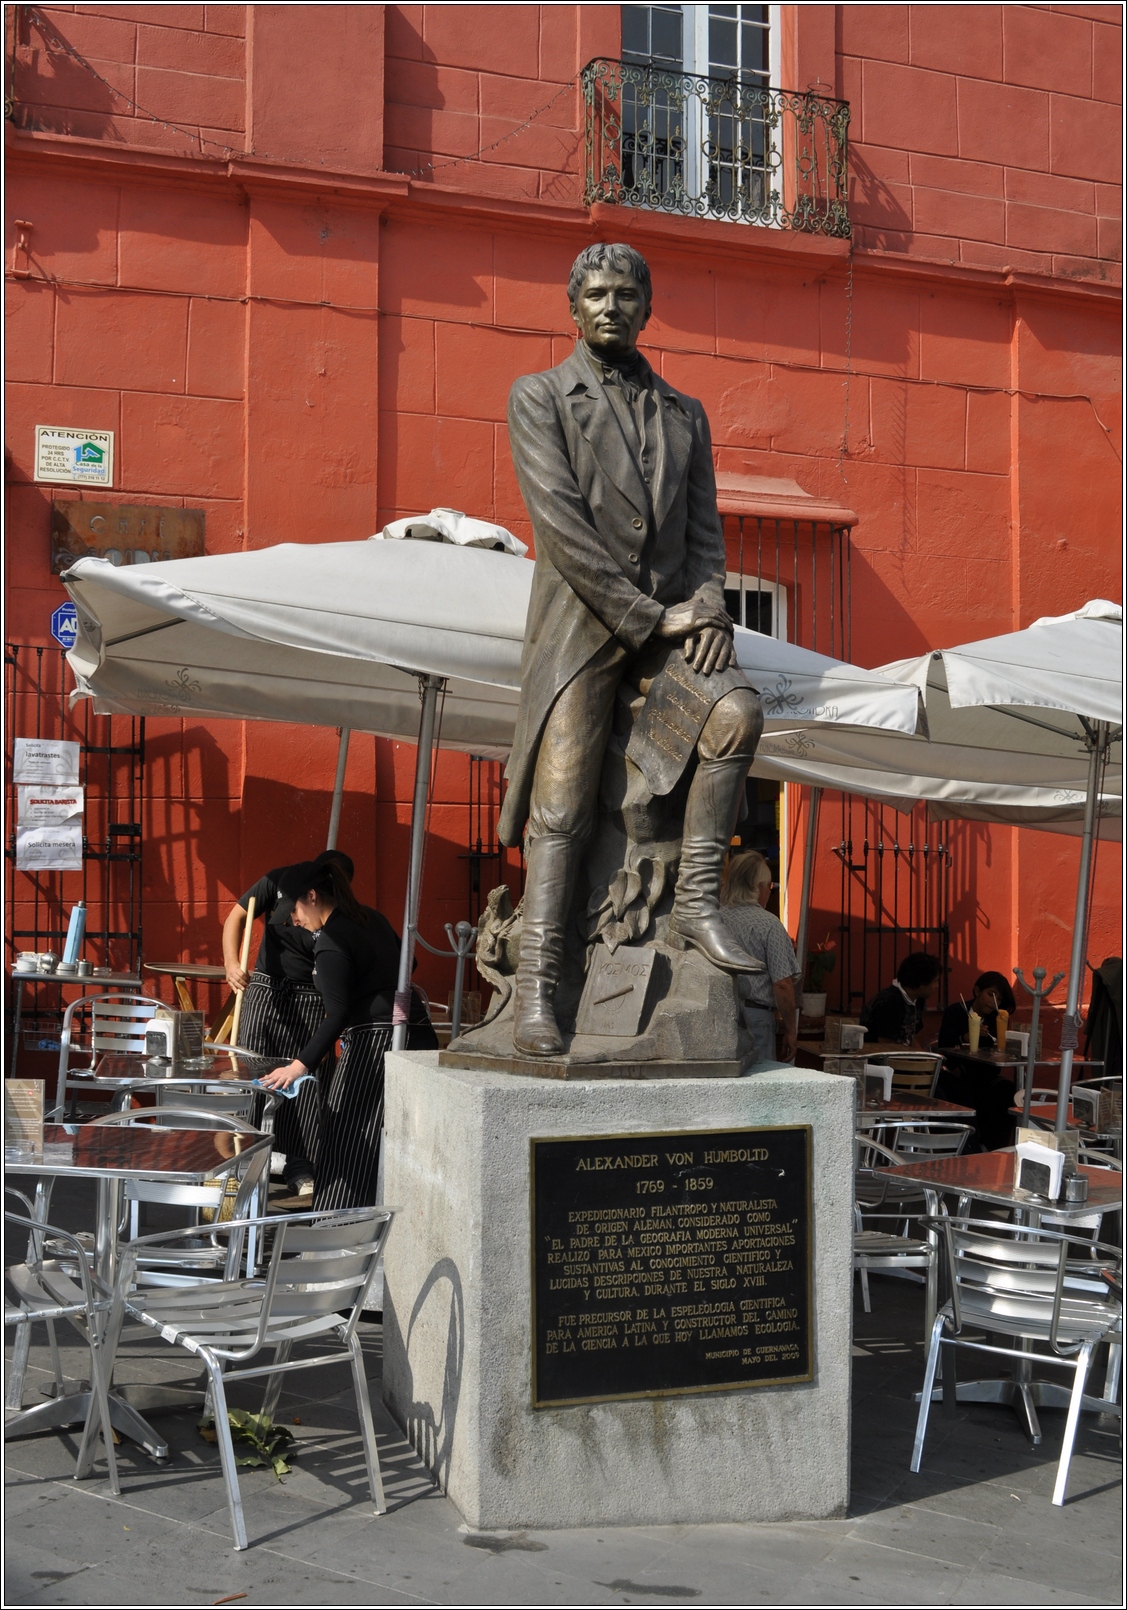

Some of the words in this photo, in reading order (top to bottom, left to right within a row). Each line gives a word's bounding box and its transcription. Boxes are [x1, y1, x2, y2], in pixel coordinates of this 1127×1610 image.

[41, 430, 107, 442] ATENCIÓN
[73, 466, 105, 474] Seguridad
[26, 751, 61, 759] lavatrastes
[576, 1155, 659, 1171] ALEXANDER
[665, 1152, 694, 1166] VON
[704, 1149, 769, 1164] HUMBOLTD
[636, 1180, 665, 1194] 1769
[685, 1178, 714, 1191] 1859
[568, 1208, 646, 1222] EXPEDICIONARIO
[652, 1204, 708, 1217] FILANTROPO
[711, 1203, 717, 1213] Y
[720, 1199, 778, 1212] NATURALISTA
[576, 1224, 589, 1235] DE
[595, 1221, 629, 1233] ORIGEN
[678, 1214, 740, 1228] CONSIDERADO
[747, 1212, 771, 1223] COMO
[548, 1251, 590, 1264] REALIZO
[598, 1248, 623, 1260] PARA
[628, 1245, 662, 1258] MEXICO
[666, 1241, 728, 1256] IMPORTANTES
[732, 1235, 796, 1250] APORTACIONES
[570, 1236, 600, 1249] PADRE
[605, 1235, 617, 1246] DE
[622, 1235, 635, 1246] LA
[641, 1231, 692, 1244] GEOGRAFIA
[697, 1228, 739, 1240] MODERNA
[564, 1262, 625, 1276] SUSTANTIVAS
[630, 1260, 644, 1271] AL
[650, 1255, 715, 1269] CONOCIMIENTO
[724, 1251, 771, 1264] CIENTIFICO
[775, 1249, 782, 1259] Y
[550, 1278, 589, 1290] LUCIDAS
[594, 1272, 665, 1287] DESCRIPCIONES
[670, 1270, 682, 1281] DE
[687, 1267, 728, 1280] NUESTRA
[736, 1261, 794, 1275] NATURALEZA
[584, 1290, 591, 1301] Y
[645, 1282, 688, 1296] DURANTE
[694, 1281, 706, 1292] EL
[711, 1278, 737, 1290] SIGLO
[559, 1315, 576, 1327] FUE
[579, 1311, 632, 1325] PRECURSOR
[636, 1309, 649, 1320] DE
[653, 1308, 666, 1319] LA
[671, 1301, 736, 1317] ESPELEOLOGIA
[740, 1297, 786, 1311] CIENTIFICA
[547, 1329, 572, 1341] PARA
[577, 1325, 619, 1339] AMERICA
[625, 1322, 657, 1334] LATINA
[662, 1320, 669, 1331] Y
[674, 1314, 737, 1330] CONSTRUCTOR
[743, 1312, 760, 1323] DEL
[766, 1309, 798, 1320] CAMINO
[546, 1342, 559, 1354] DE
[563, 1342, 576, 1353] LA
[582, 1338, 617, 1351] CIENCIA
[622, 1337, 630, 1347] A
[635, 1335, 648, 1346] LA
[653, 1333, 671, 1344] QUE
[675, 1331, 693, 1343] HOY
[700, 1326, 749, 1340] LLAMAMOS
[705, 1349, 740, 1360] MUNICIPIO
[743, 1348, 752, 1356] DE
[756, 1344, 799, 1354] CUERNAVACA
[742, 1356, 761, 1365] MAYO
[782, 1352, 800, 1360] 2009
